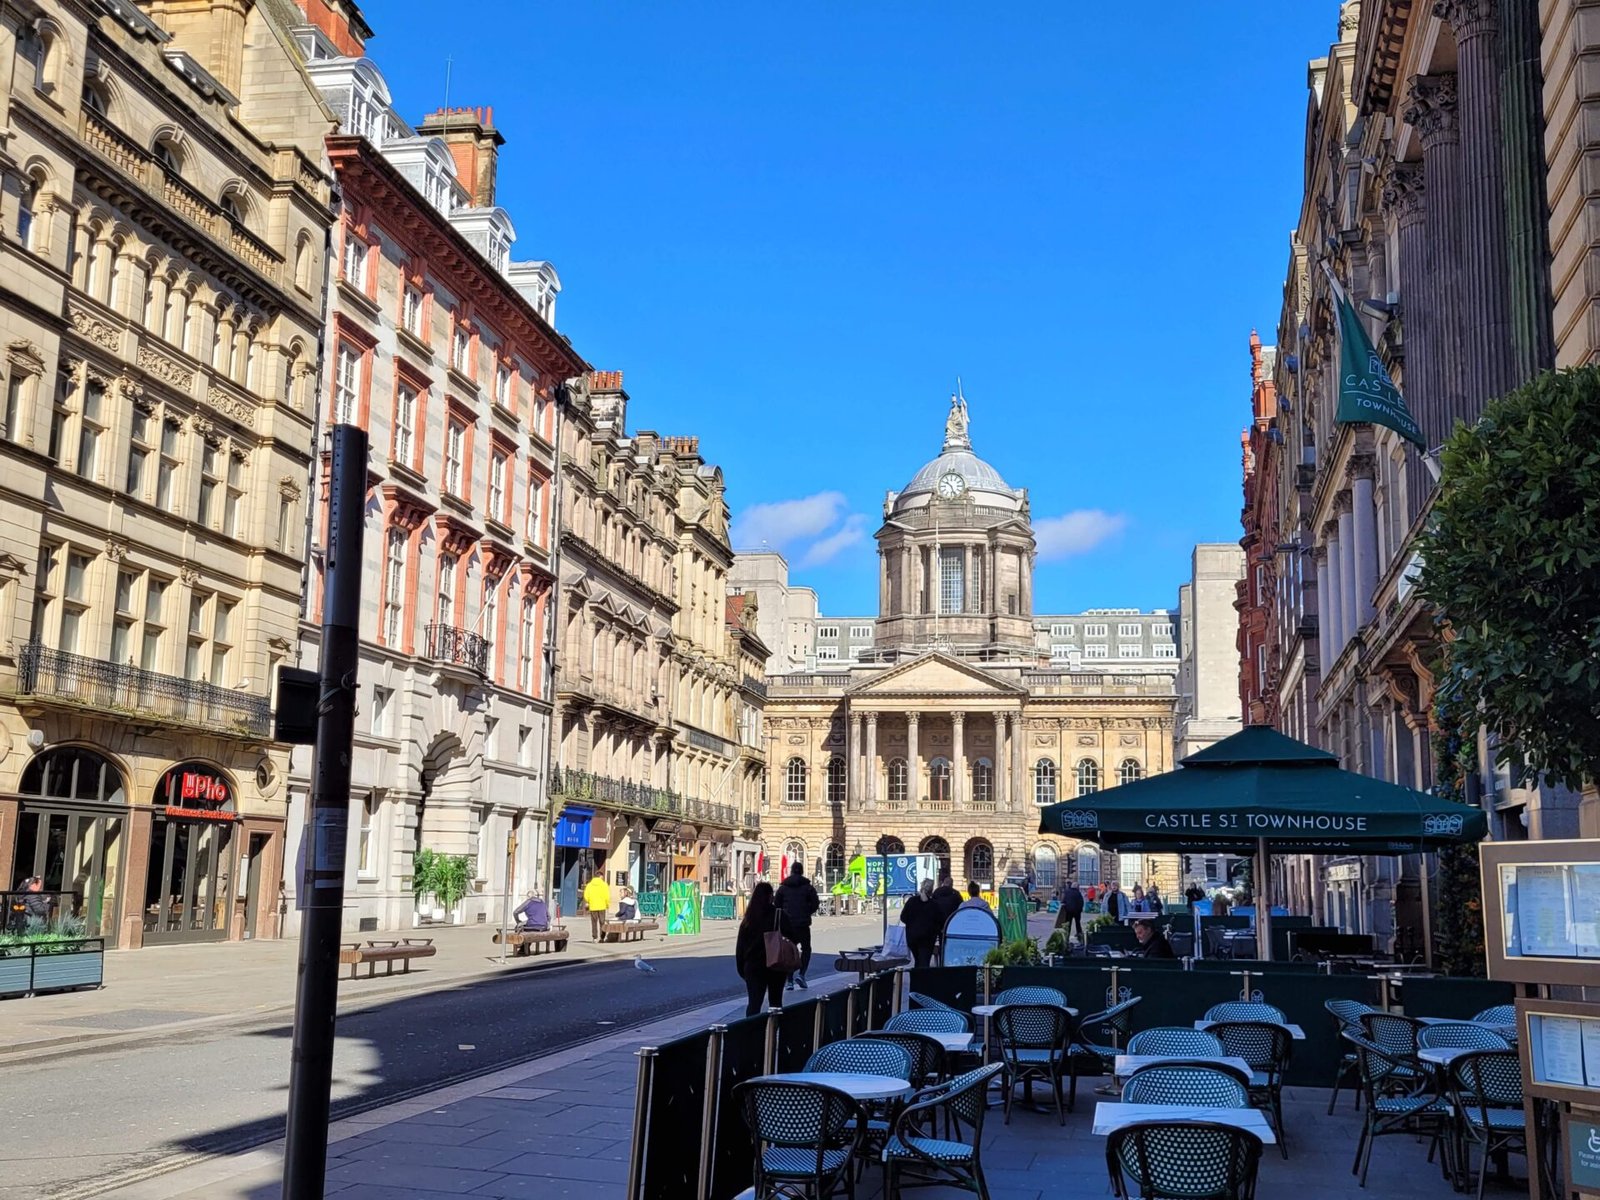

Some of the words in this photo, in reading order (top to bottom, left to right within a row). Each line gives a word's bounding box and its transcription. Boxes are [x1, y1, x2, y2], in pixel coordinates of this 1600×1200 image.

[1345, 374, 1406, 410] CASLE
[195, 776, 227, 801] Pho
[1145, 814, 1212, 828] CASTLE
[1246, 814, 1368, 831] TOWNHOUSE
[637, 894, 662, 903] PASTA
